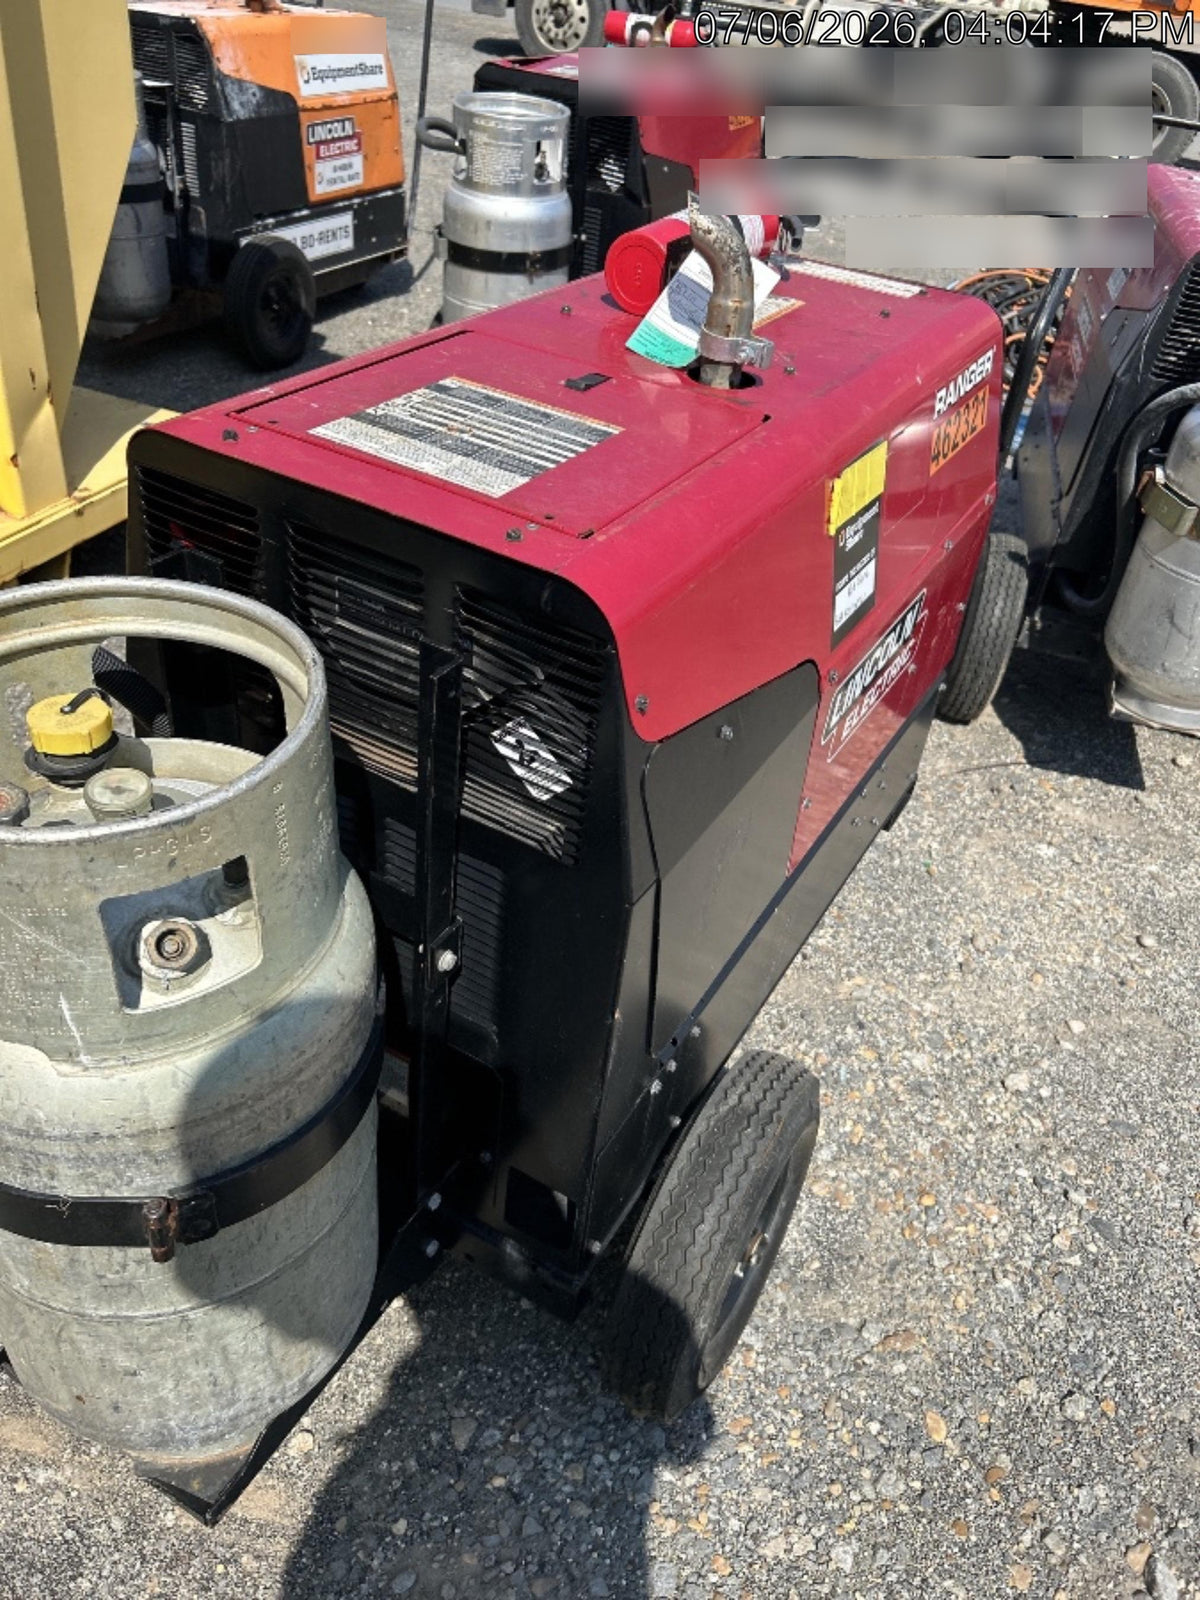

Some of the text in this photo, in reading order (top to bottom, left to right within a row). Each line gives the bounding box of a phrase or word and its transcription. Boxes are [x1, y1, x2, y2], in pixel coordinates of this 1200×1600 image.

[311, 63, 383, 82] EquipmentShare
[309, 122, 353, 141] LINCOLN
[320, 140, 358, 157] ELECTRIC
[933, 348, 994, 420] RANGER
[931, 390, 987, 467] 462321
[830, 603, 920, 728] LINCOLN
[841, 638, 916, 741] ELECTRIC
